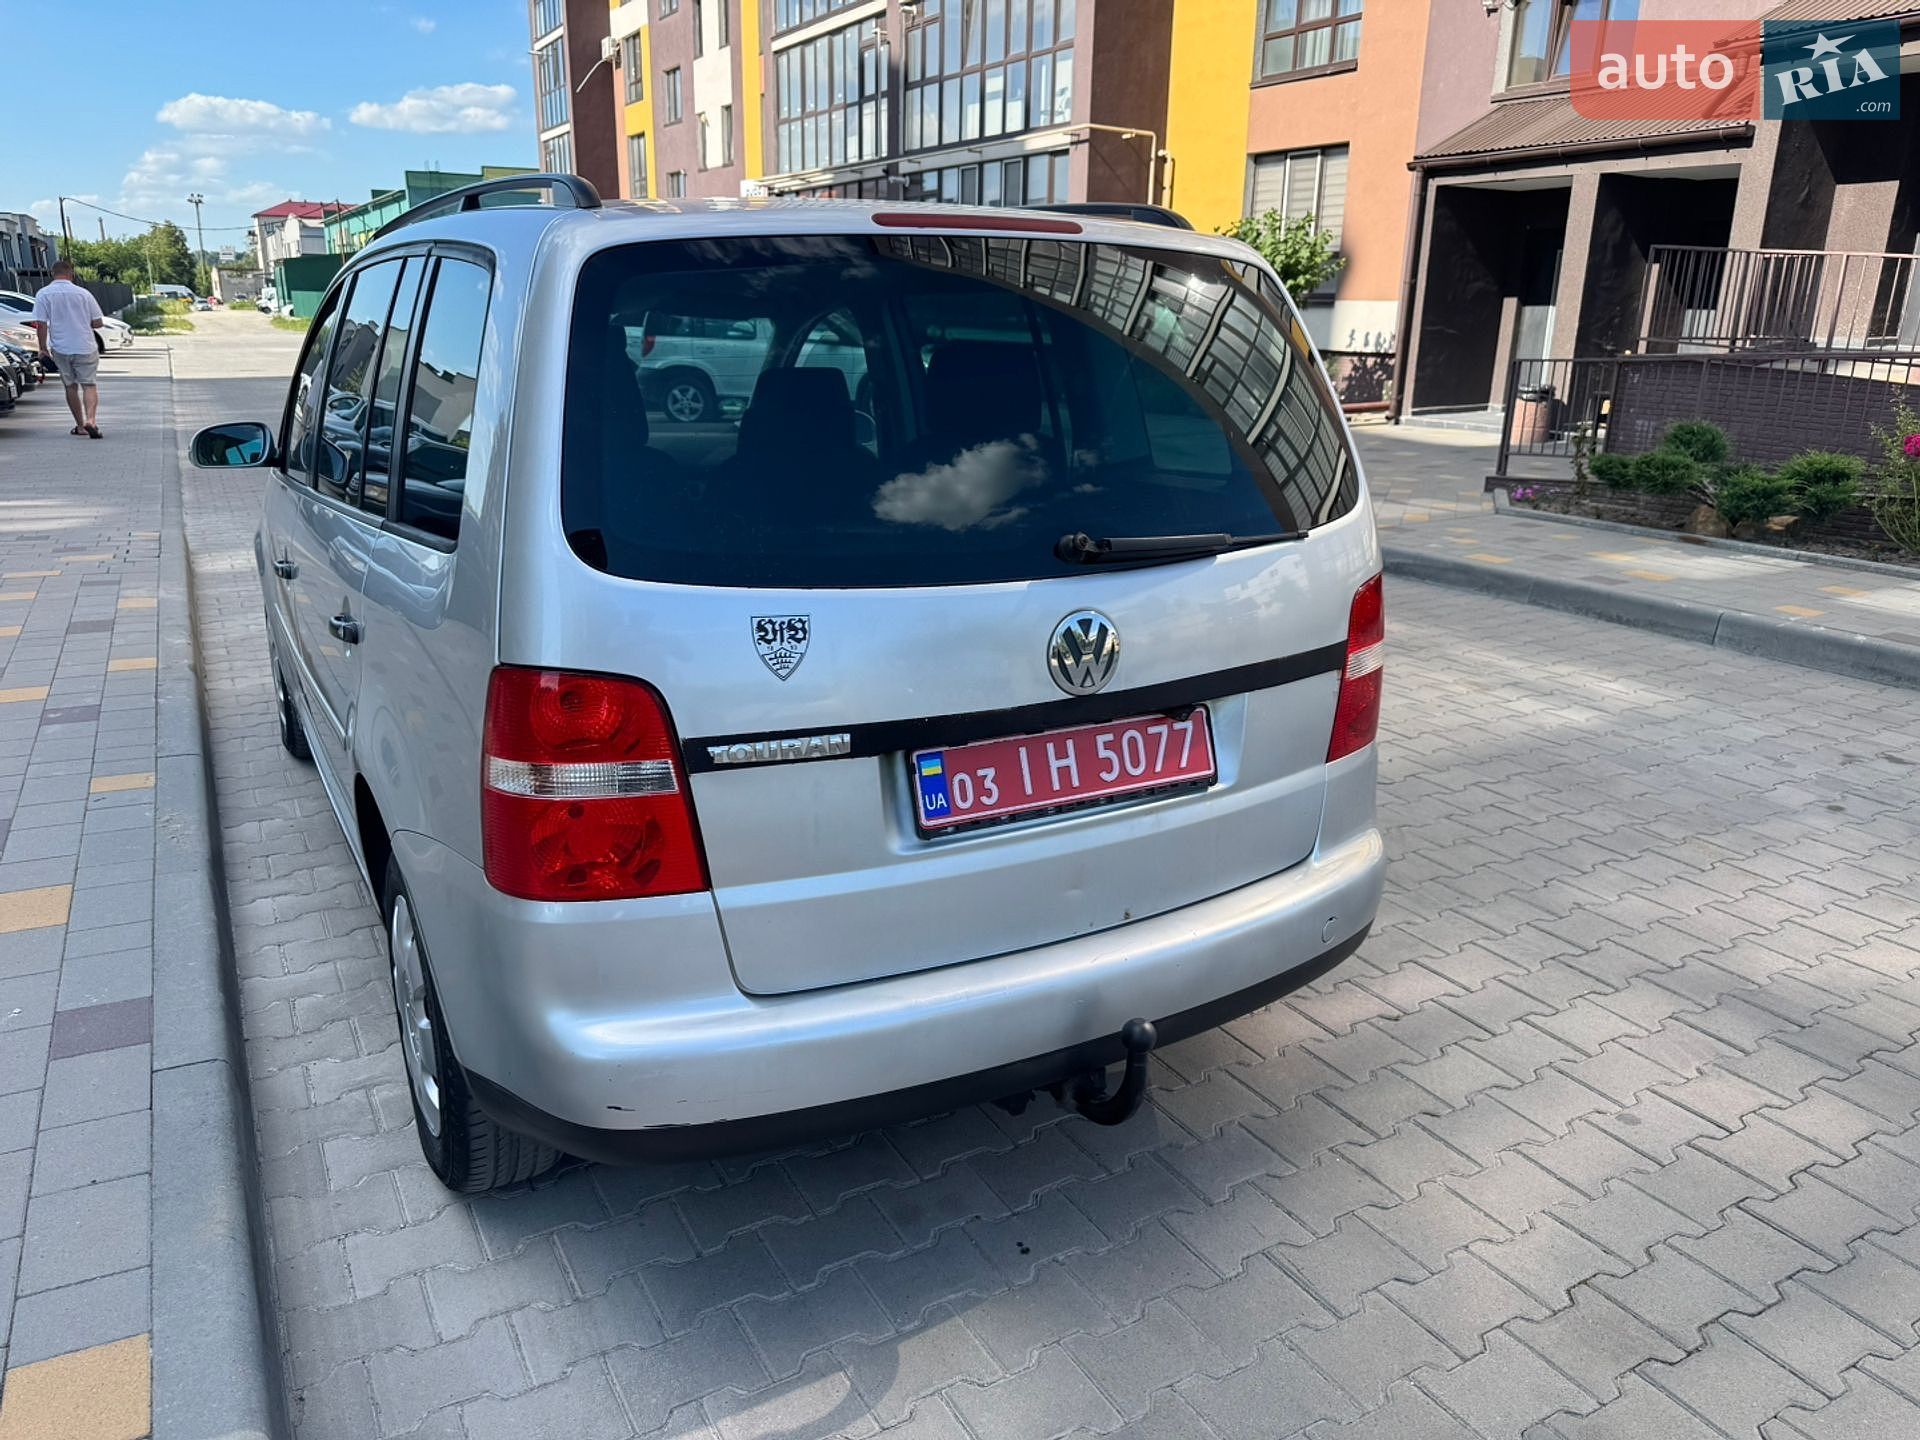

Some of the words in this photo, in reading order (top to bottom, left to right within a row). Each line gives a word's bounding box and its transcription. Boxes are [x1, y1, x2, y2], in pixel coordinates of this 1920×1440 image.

[706, 732, 851, 764] TOURAN
[951, 766, 1000, 810] 03
[1018, 738, 1080, 796] IH
[1095, 719, 1194, 783] 5077
[925, 791, 948, 811] UA
